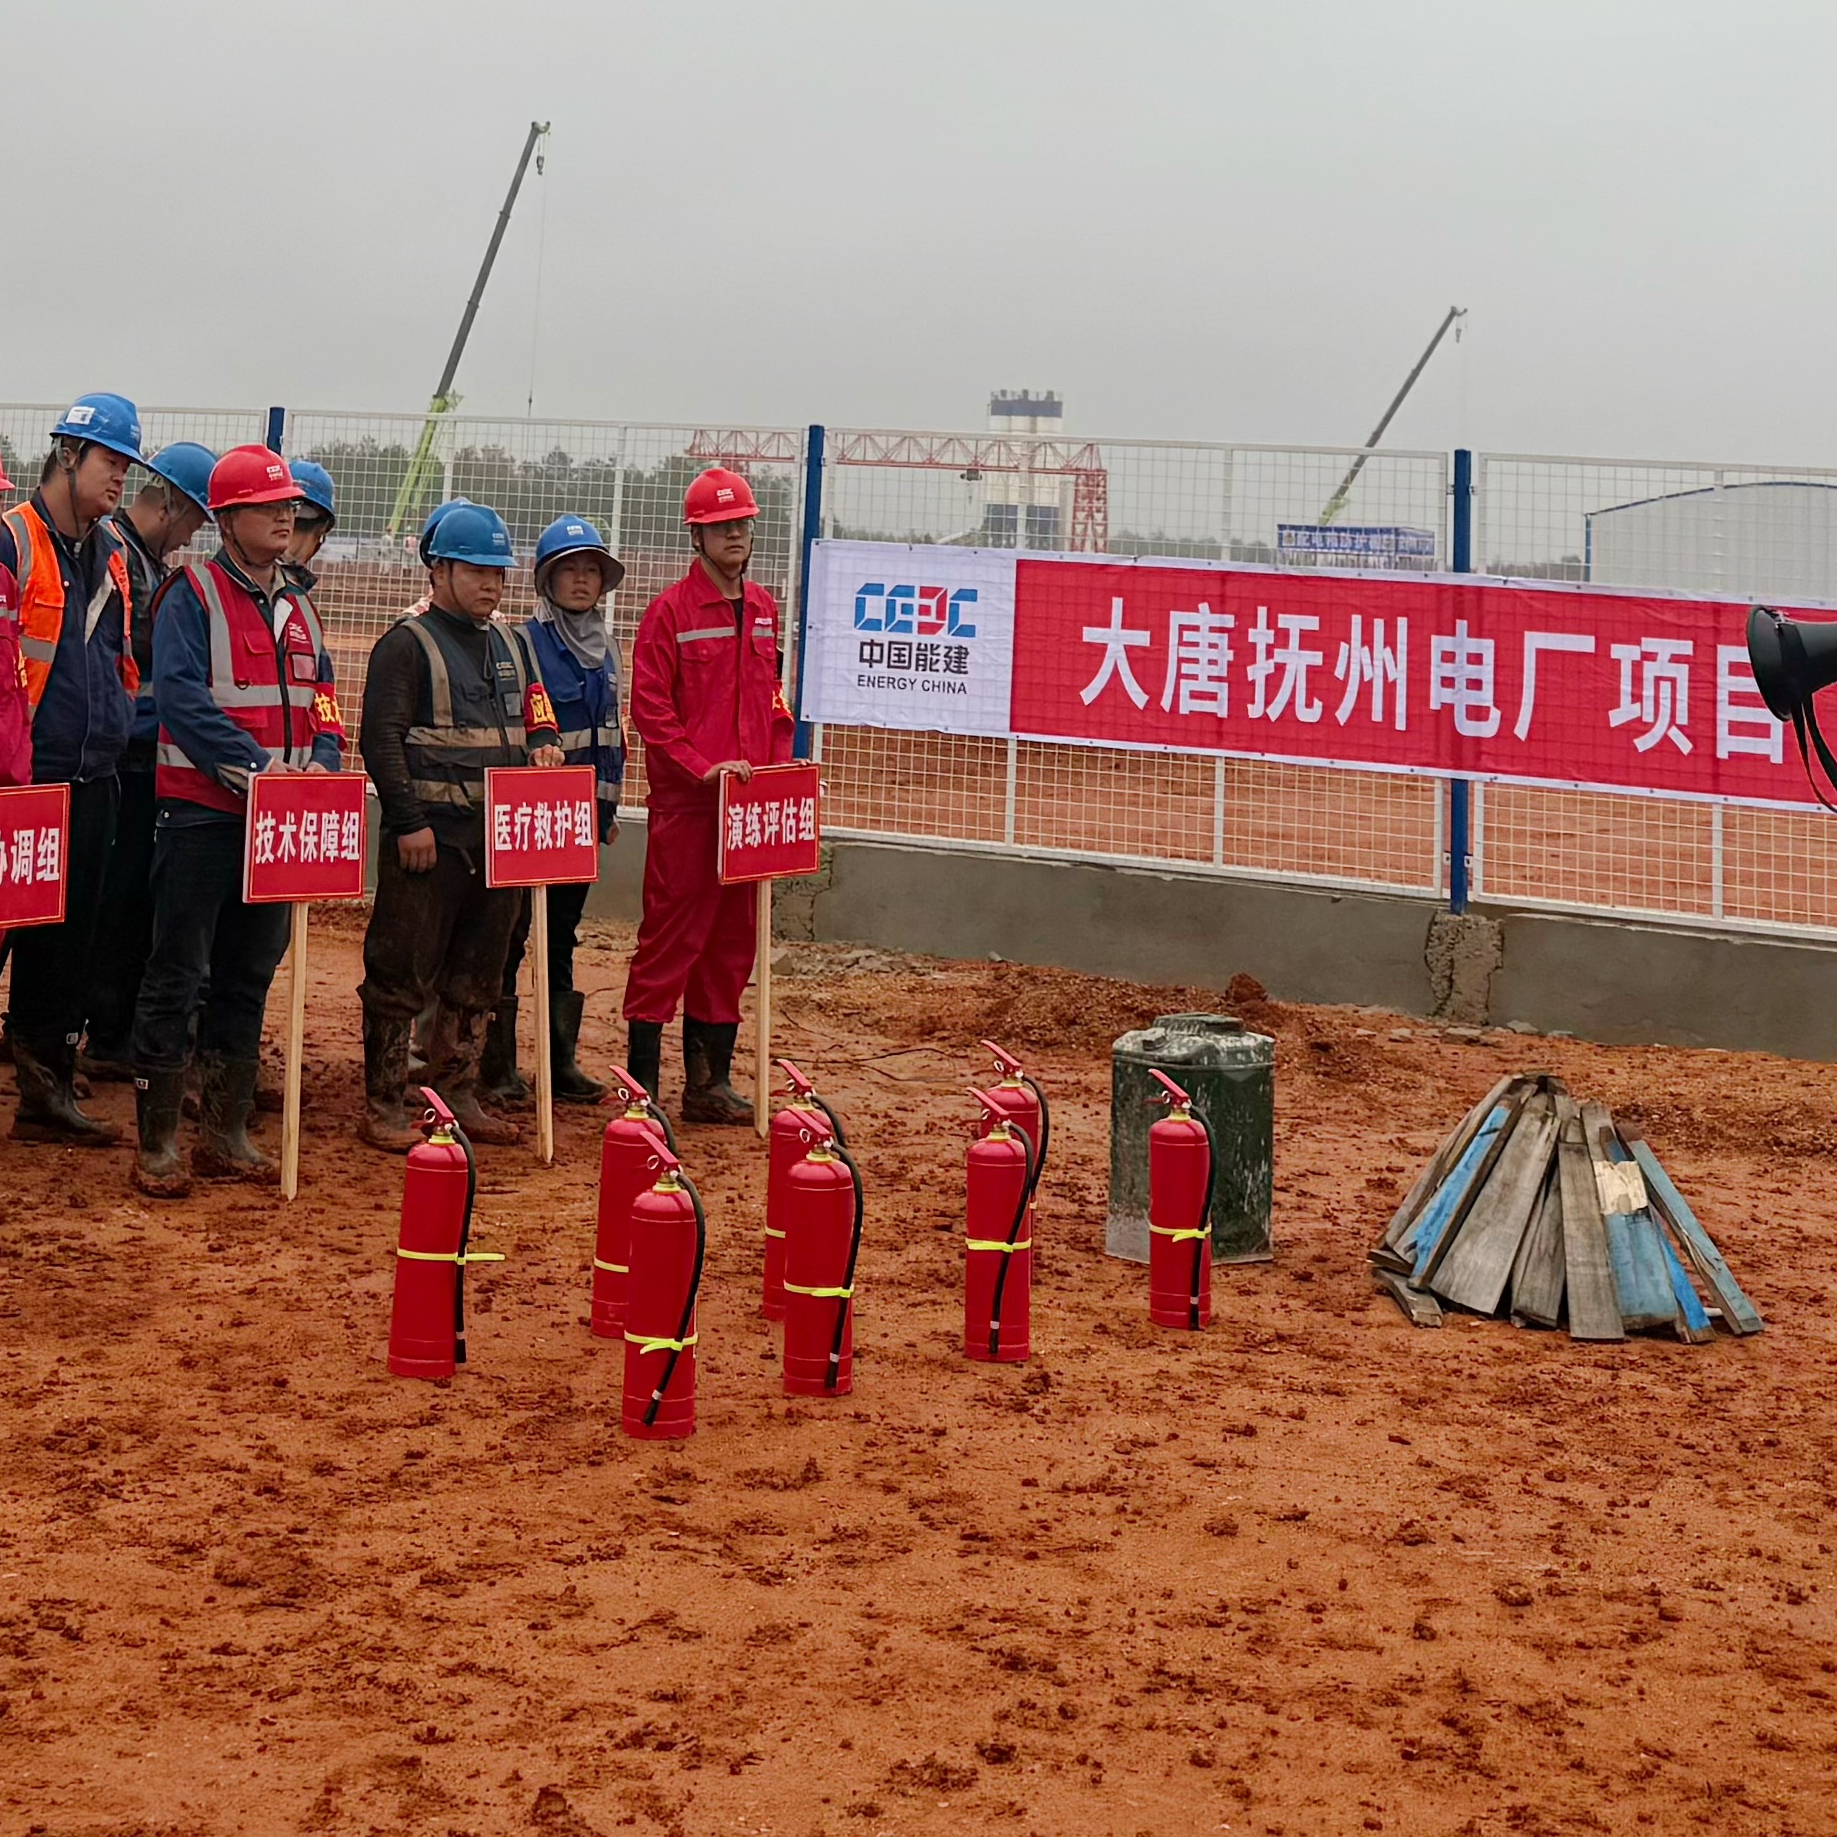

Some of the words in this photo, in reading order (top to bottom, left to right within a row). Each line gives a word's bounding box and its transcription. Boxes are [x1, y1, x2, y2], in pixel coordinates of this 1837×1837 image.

[859, 639, 969, 675] 中国能建
[857, 674, 917, 691] ENERGY
[921, 679, 968, 695] CHINA
[255, 809, 360, 864] 技术保障组
[494, 800, 594, 852] 医疗救护组
[727, 797, 816, 851] 演练评估组
